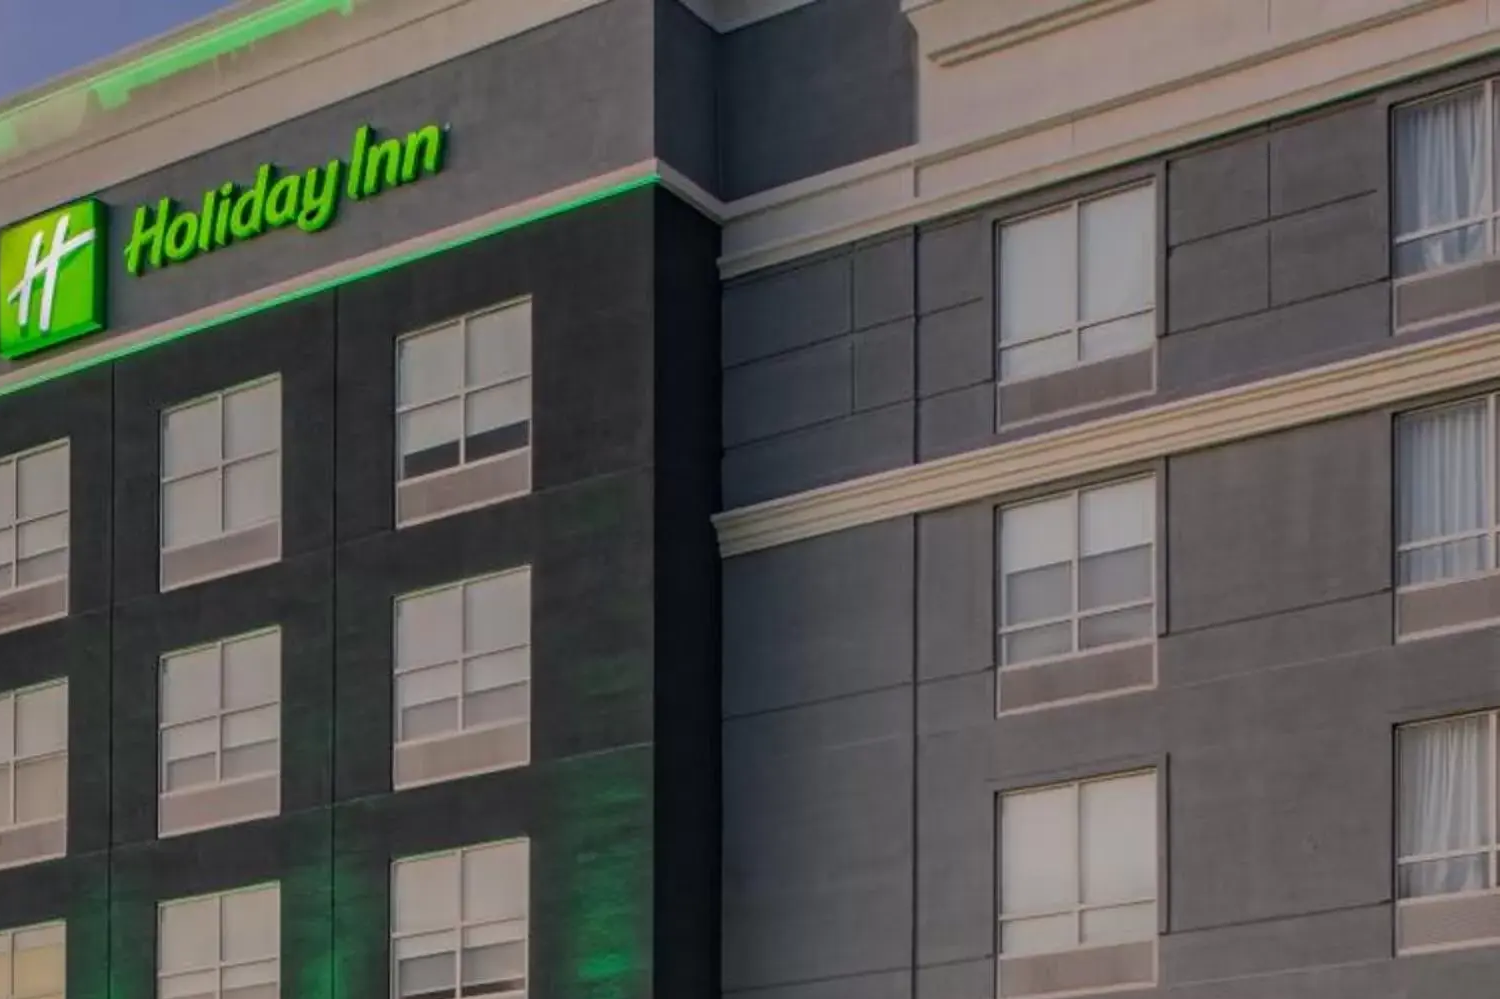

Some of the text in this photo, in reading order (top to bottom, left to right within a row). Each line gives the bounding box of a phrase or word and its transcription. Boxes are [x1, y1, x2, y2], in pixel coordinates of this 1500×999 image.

[125, 121, 443, 275] Holiday Inn
[7, 212, 97, 332] H
